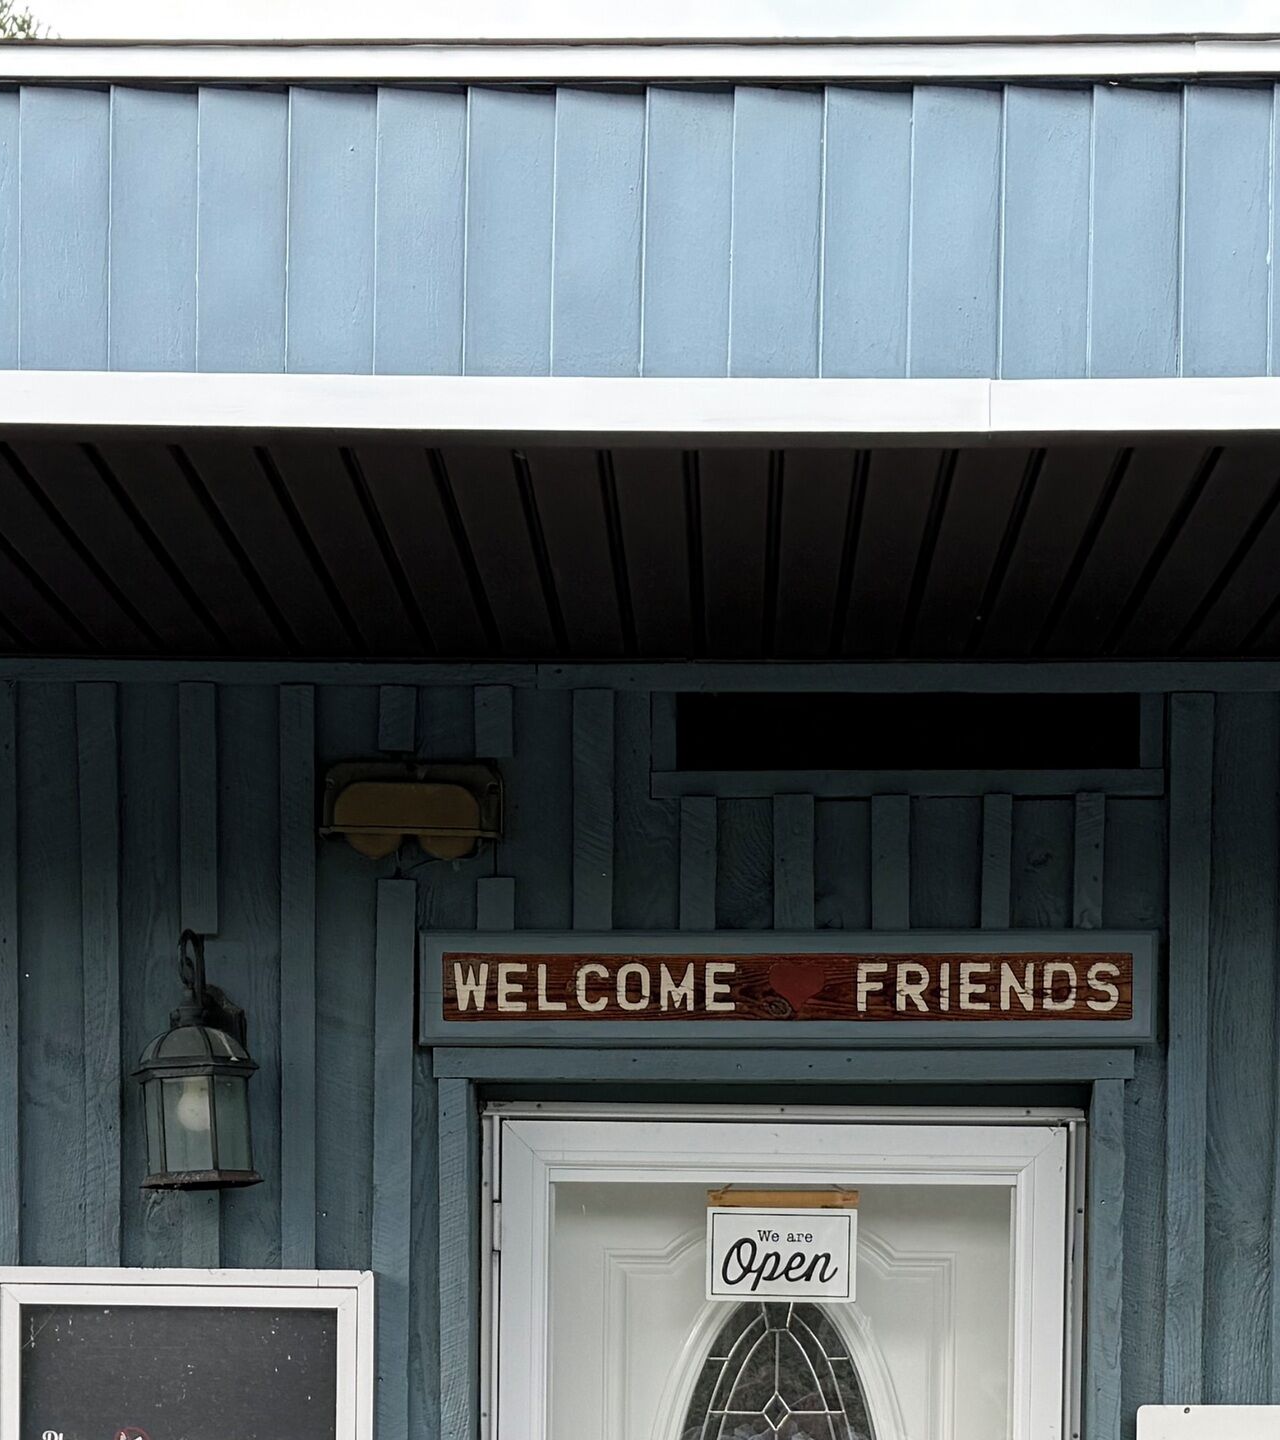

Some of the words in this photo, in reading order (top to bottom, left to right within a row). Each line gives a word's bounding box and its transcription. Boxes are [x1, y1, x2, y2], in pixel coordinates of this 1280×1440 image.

[452, 962, 737, 1013] WELCOME
[856, 962, 1121, 1013] FRIENDS
[757, 1229, 780, 1242] We
[786, 1231, 813, 1243] are
[721, 1237, 838, 1292] Open
